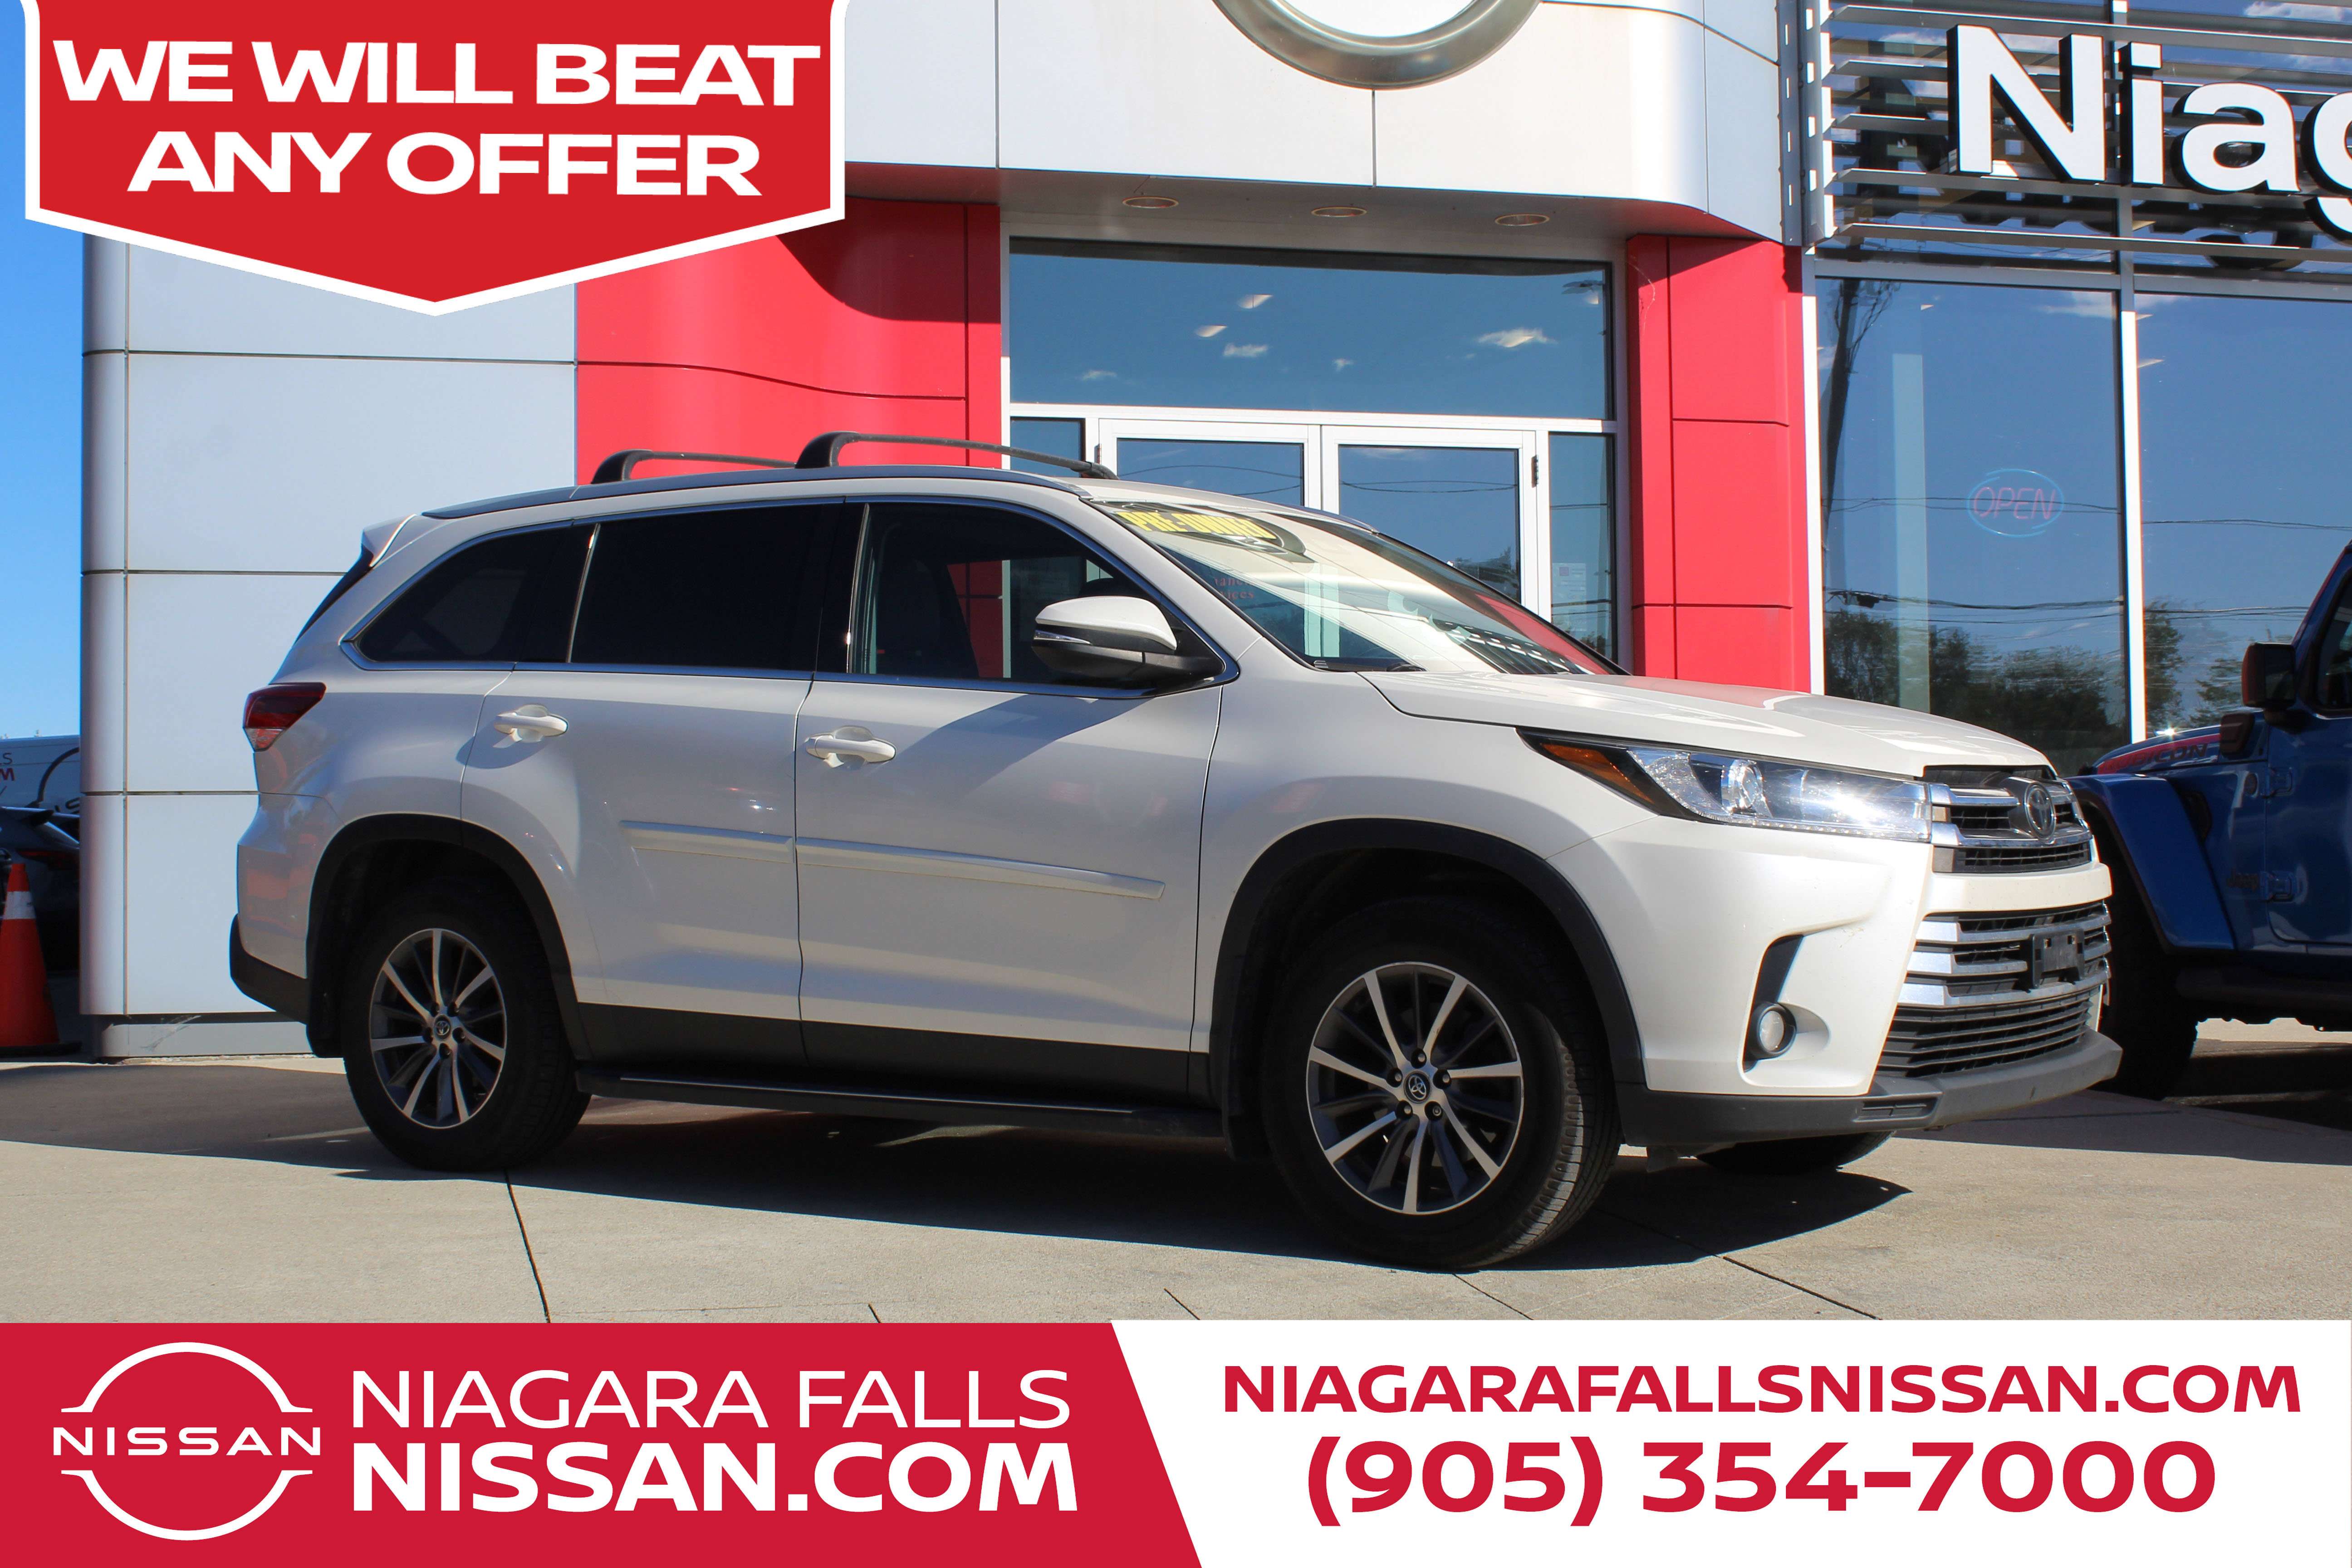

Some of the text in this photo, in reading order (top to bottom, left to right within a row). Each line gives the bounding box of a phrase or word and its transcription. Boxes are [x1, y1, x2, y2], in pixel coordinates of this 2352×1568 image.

[1974, 486, 2056, 519] OPEN
[1114, 512, 1277, 539] PRE-OWNED
[2104, 743, 2208, 772] RUBICON
